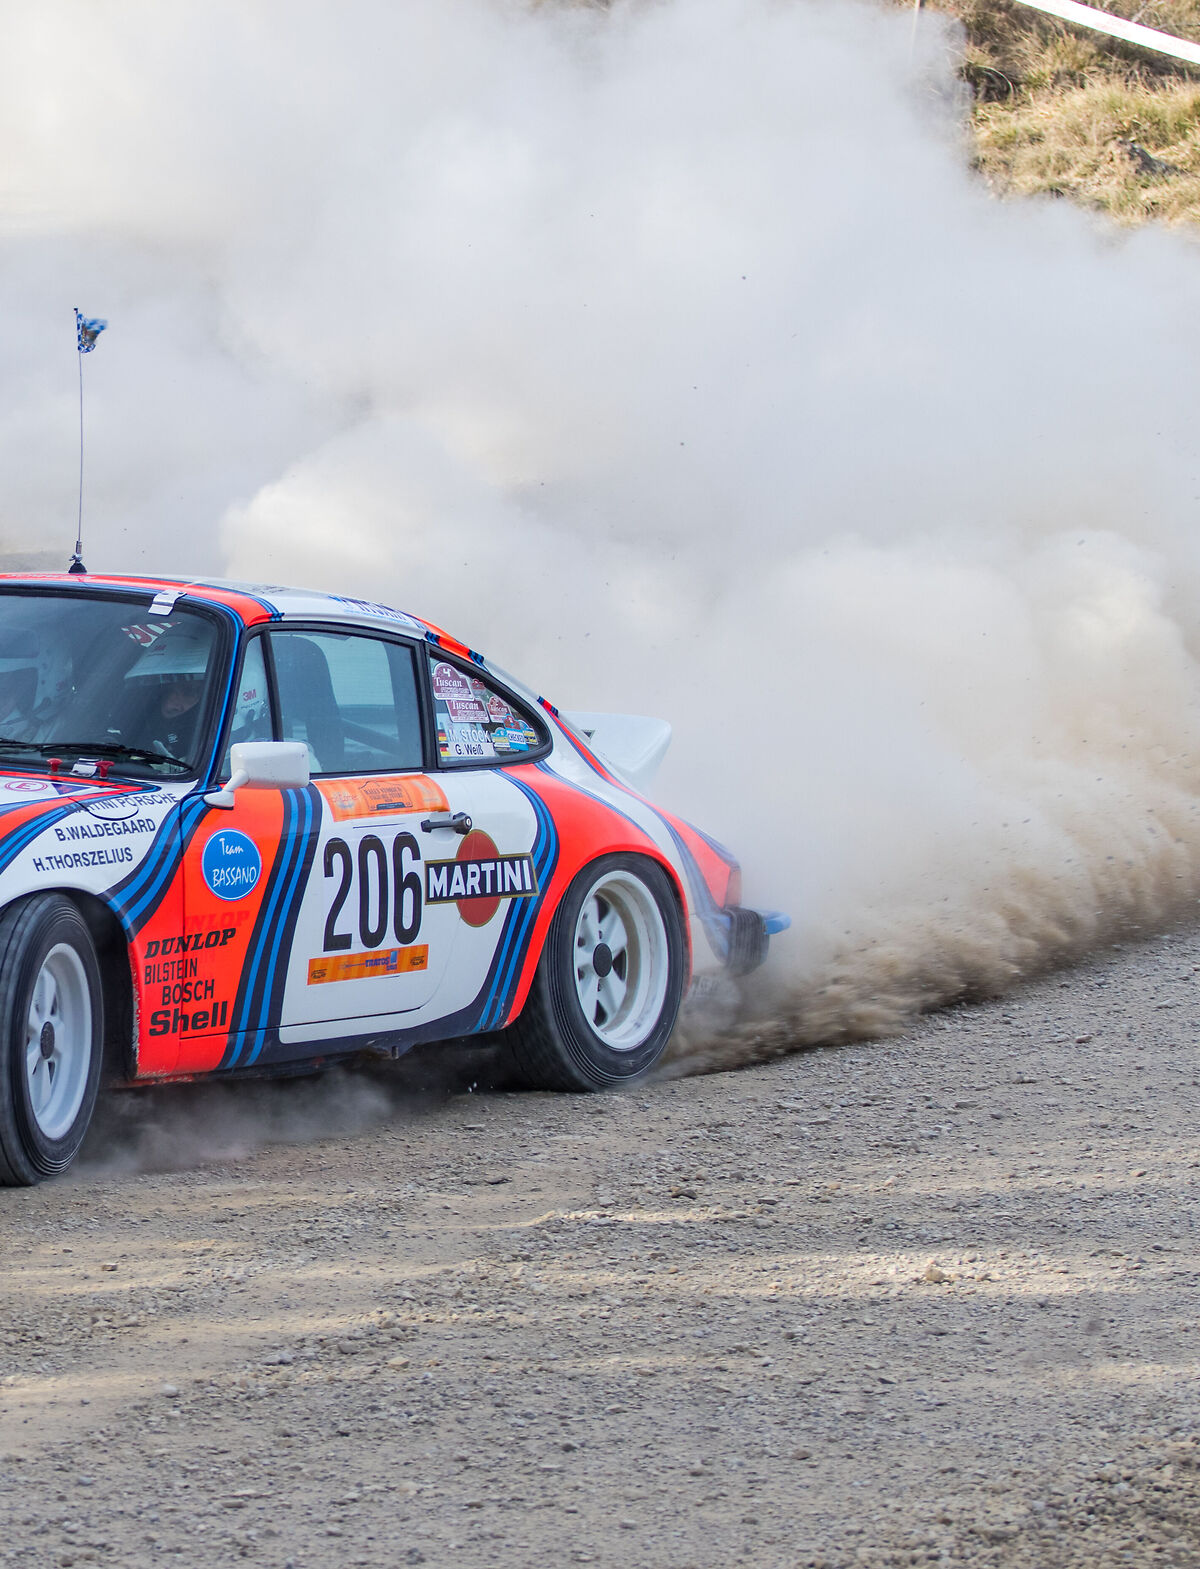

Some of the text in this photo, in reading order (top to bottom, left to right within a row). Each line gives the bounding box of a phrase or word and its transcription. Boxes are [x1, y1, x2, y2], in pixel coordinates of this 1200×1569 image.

[434, 677, 463, 688] Tuscan
[455, 743, 464, 755] G.
[119, 793, 178, 808] PORSCHE
[33, 847, 133, 872] H.THORSZELIUS
[219, 838, 244, 856] Team
[212, 866, 256, 887] BASSANO
[429, 859, 532, 899] MARTINI
[323, 831, 423, 952] 206
[144, 928, 236, 959] DUNLOP
[144, 958, 198, 985] BILSTEIN
[161, 979, 215, 1006] BOSCH
[149, 1001, 228, 1036] Shell
